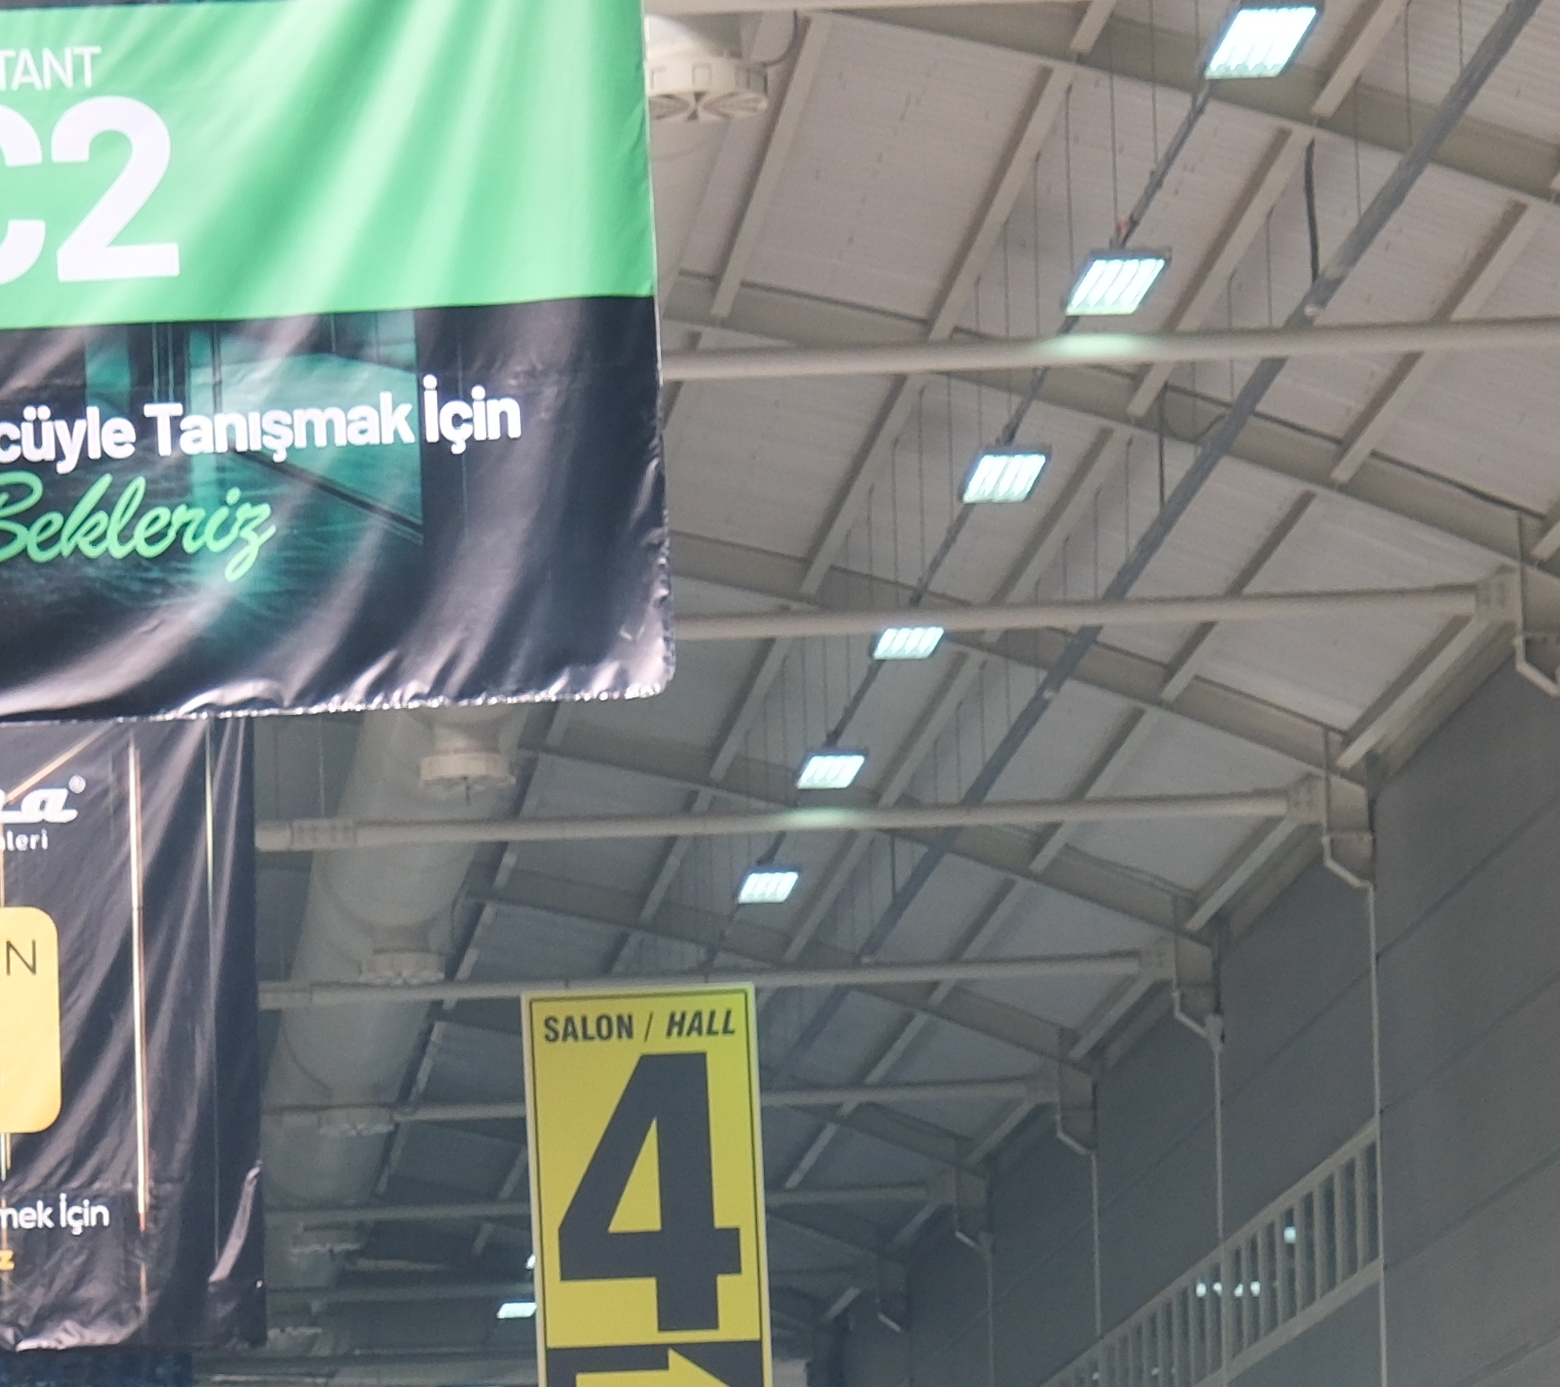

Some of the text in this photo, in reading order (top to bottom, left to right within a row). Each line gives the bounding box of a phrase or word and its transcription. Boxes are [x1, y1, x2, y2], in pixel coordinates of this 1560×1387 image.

[143, 389, 416, 461] Tanışmak
[421, 373, 523, 452] İçin
[544, 1009, 737, 1043] SALON / HALL
[58, 1194, 110, 1235] İçin
[558, 1051, 743, 1333] 4
